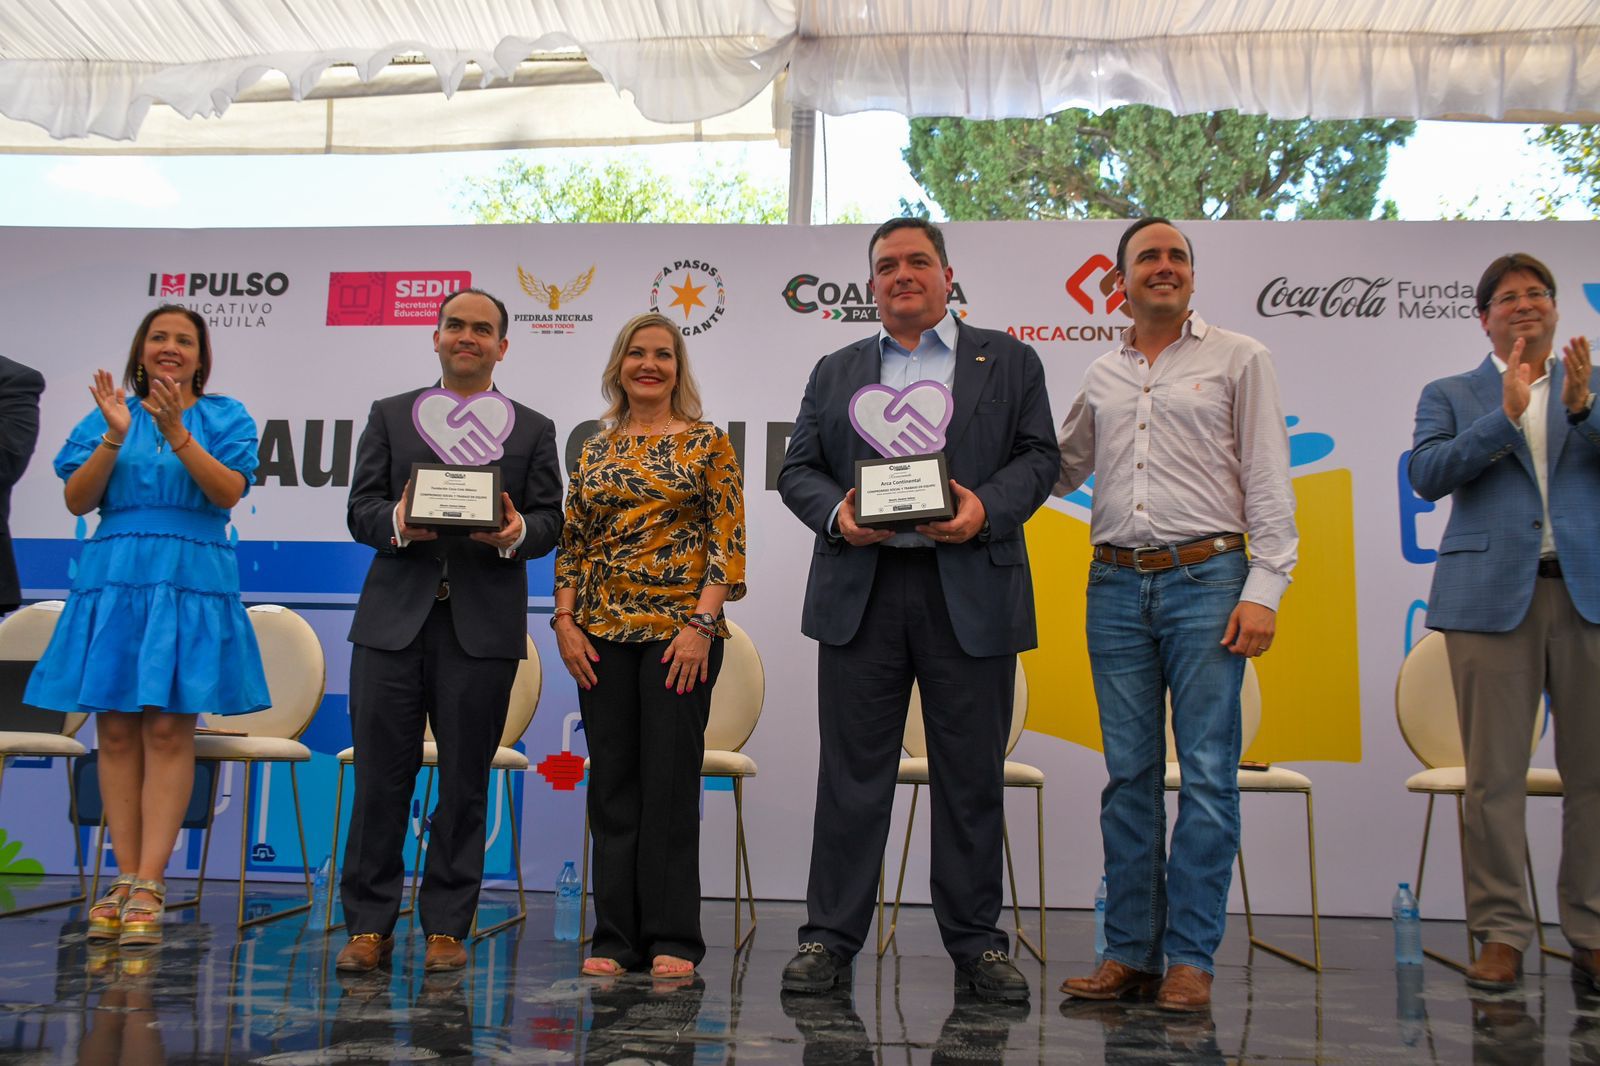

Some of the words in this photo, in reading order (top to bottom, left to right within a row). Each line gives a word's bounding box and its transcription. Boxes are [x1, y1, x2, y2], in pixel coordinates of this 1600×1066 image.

[662, 266, 673, 277] A
[674, 259, 718, 277] PASOS
[148, 272, 289, 297] IMPULSO
[395, 279, 461, 298] SEDU
[1397, 280, 1477, 299] Funda
[394, 301, 437, 309] Secretaría
[1256, 276, 1394, 318] Coca-Cola
[394, 309, 438, 318] Educación
[514, 314, 553, 322] PIEDRAS
[555, 314, 593, 322] NEGRAS
[678, 305, 725, 336] GANTE
[892, 478, 921, 486] Continental
